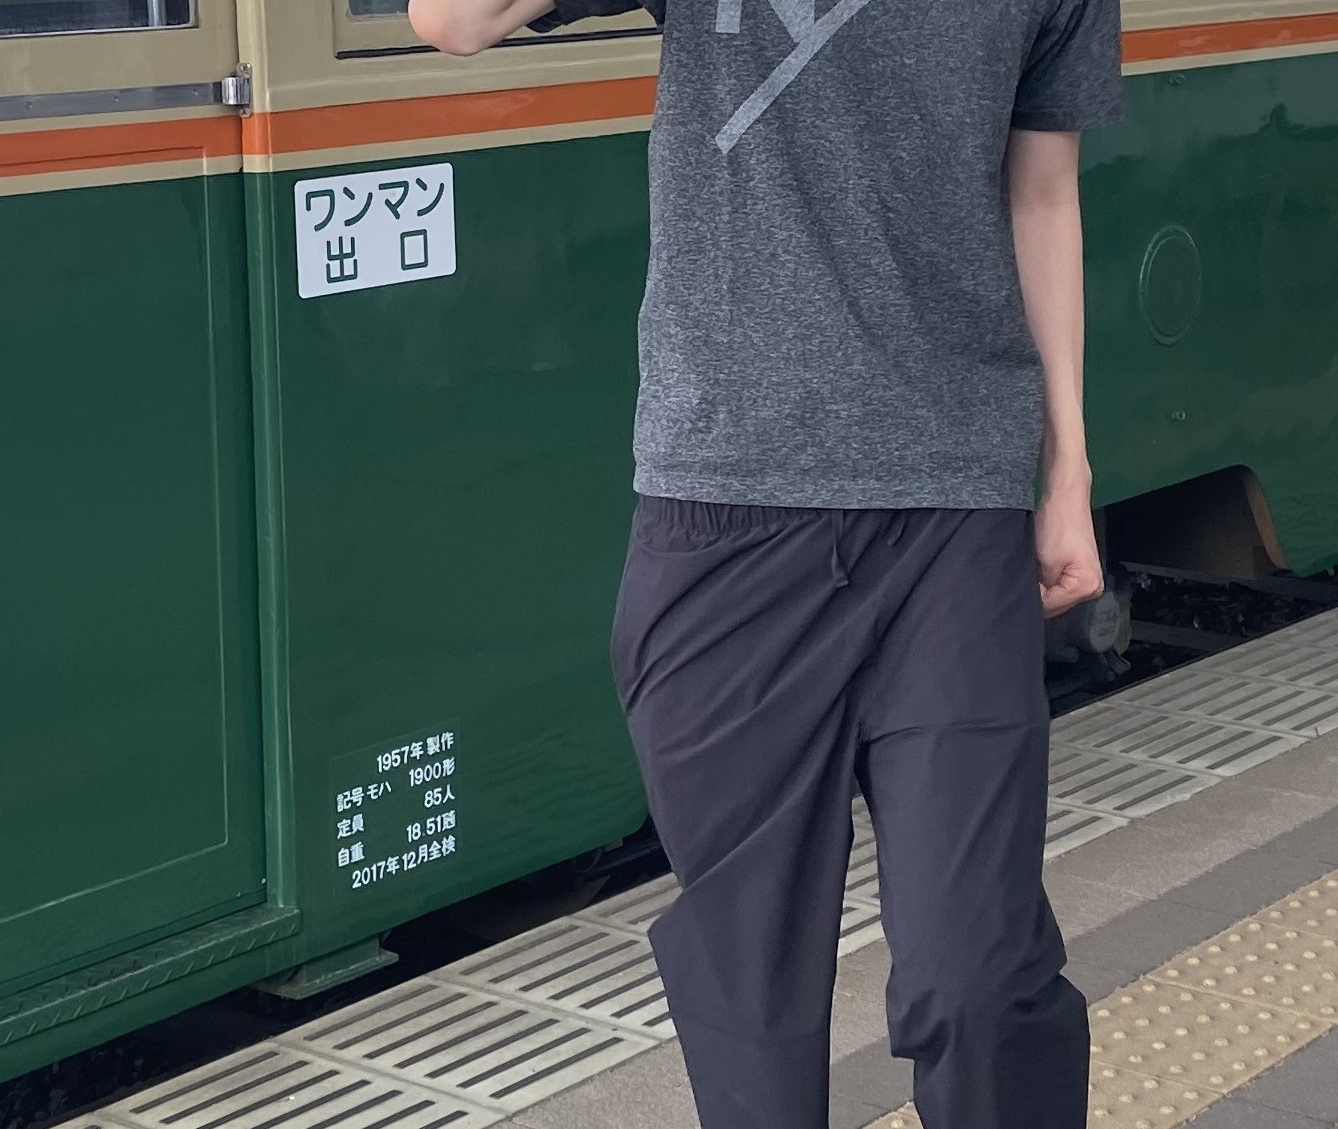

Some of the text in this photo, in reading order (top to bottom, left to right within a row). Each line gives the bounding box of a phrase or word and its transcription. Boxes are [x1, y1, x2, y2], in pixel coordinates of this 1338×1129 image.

[306, 177, 445, 232] ワンマン
[409, 757, 455, 787] 1900形
[337, 784, 456, 839] 定員 85人
[338, 841, 365, 867] 自重
